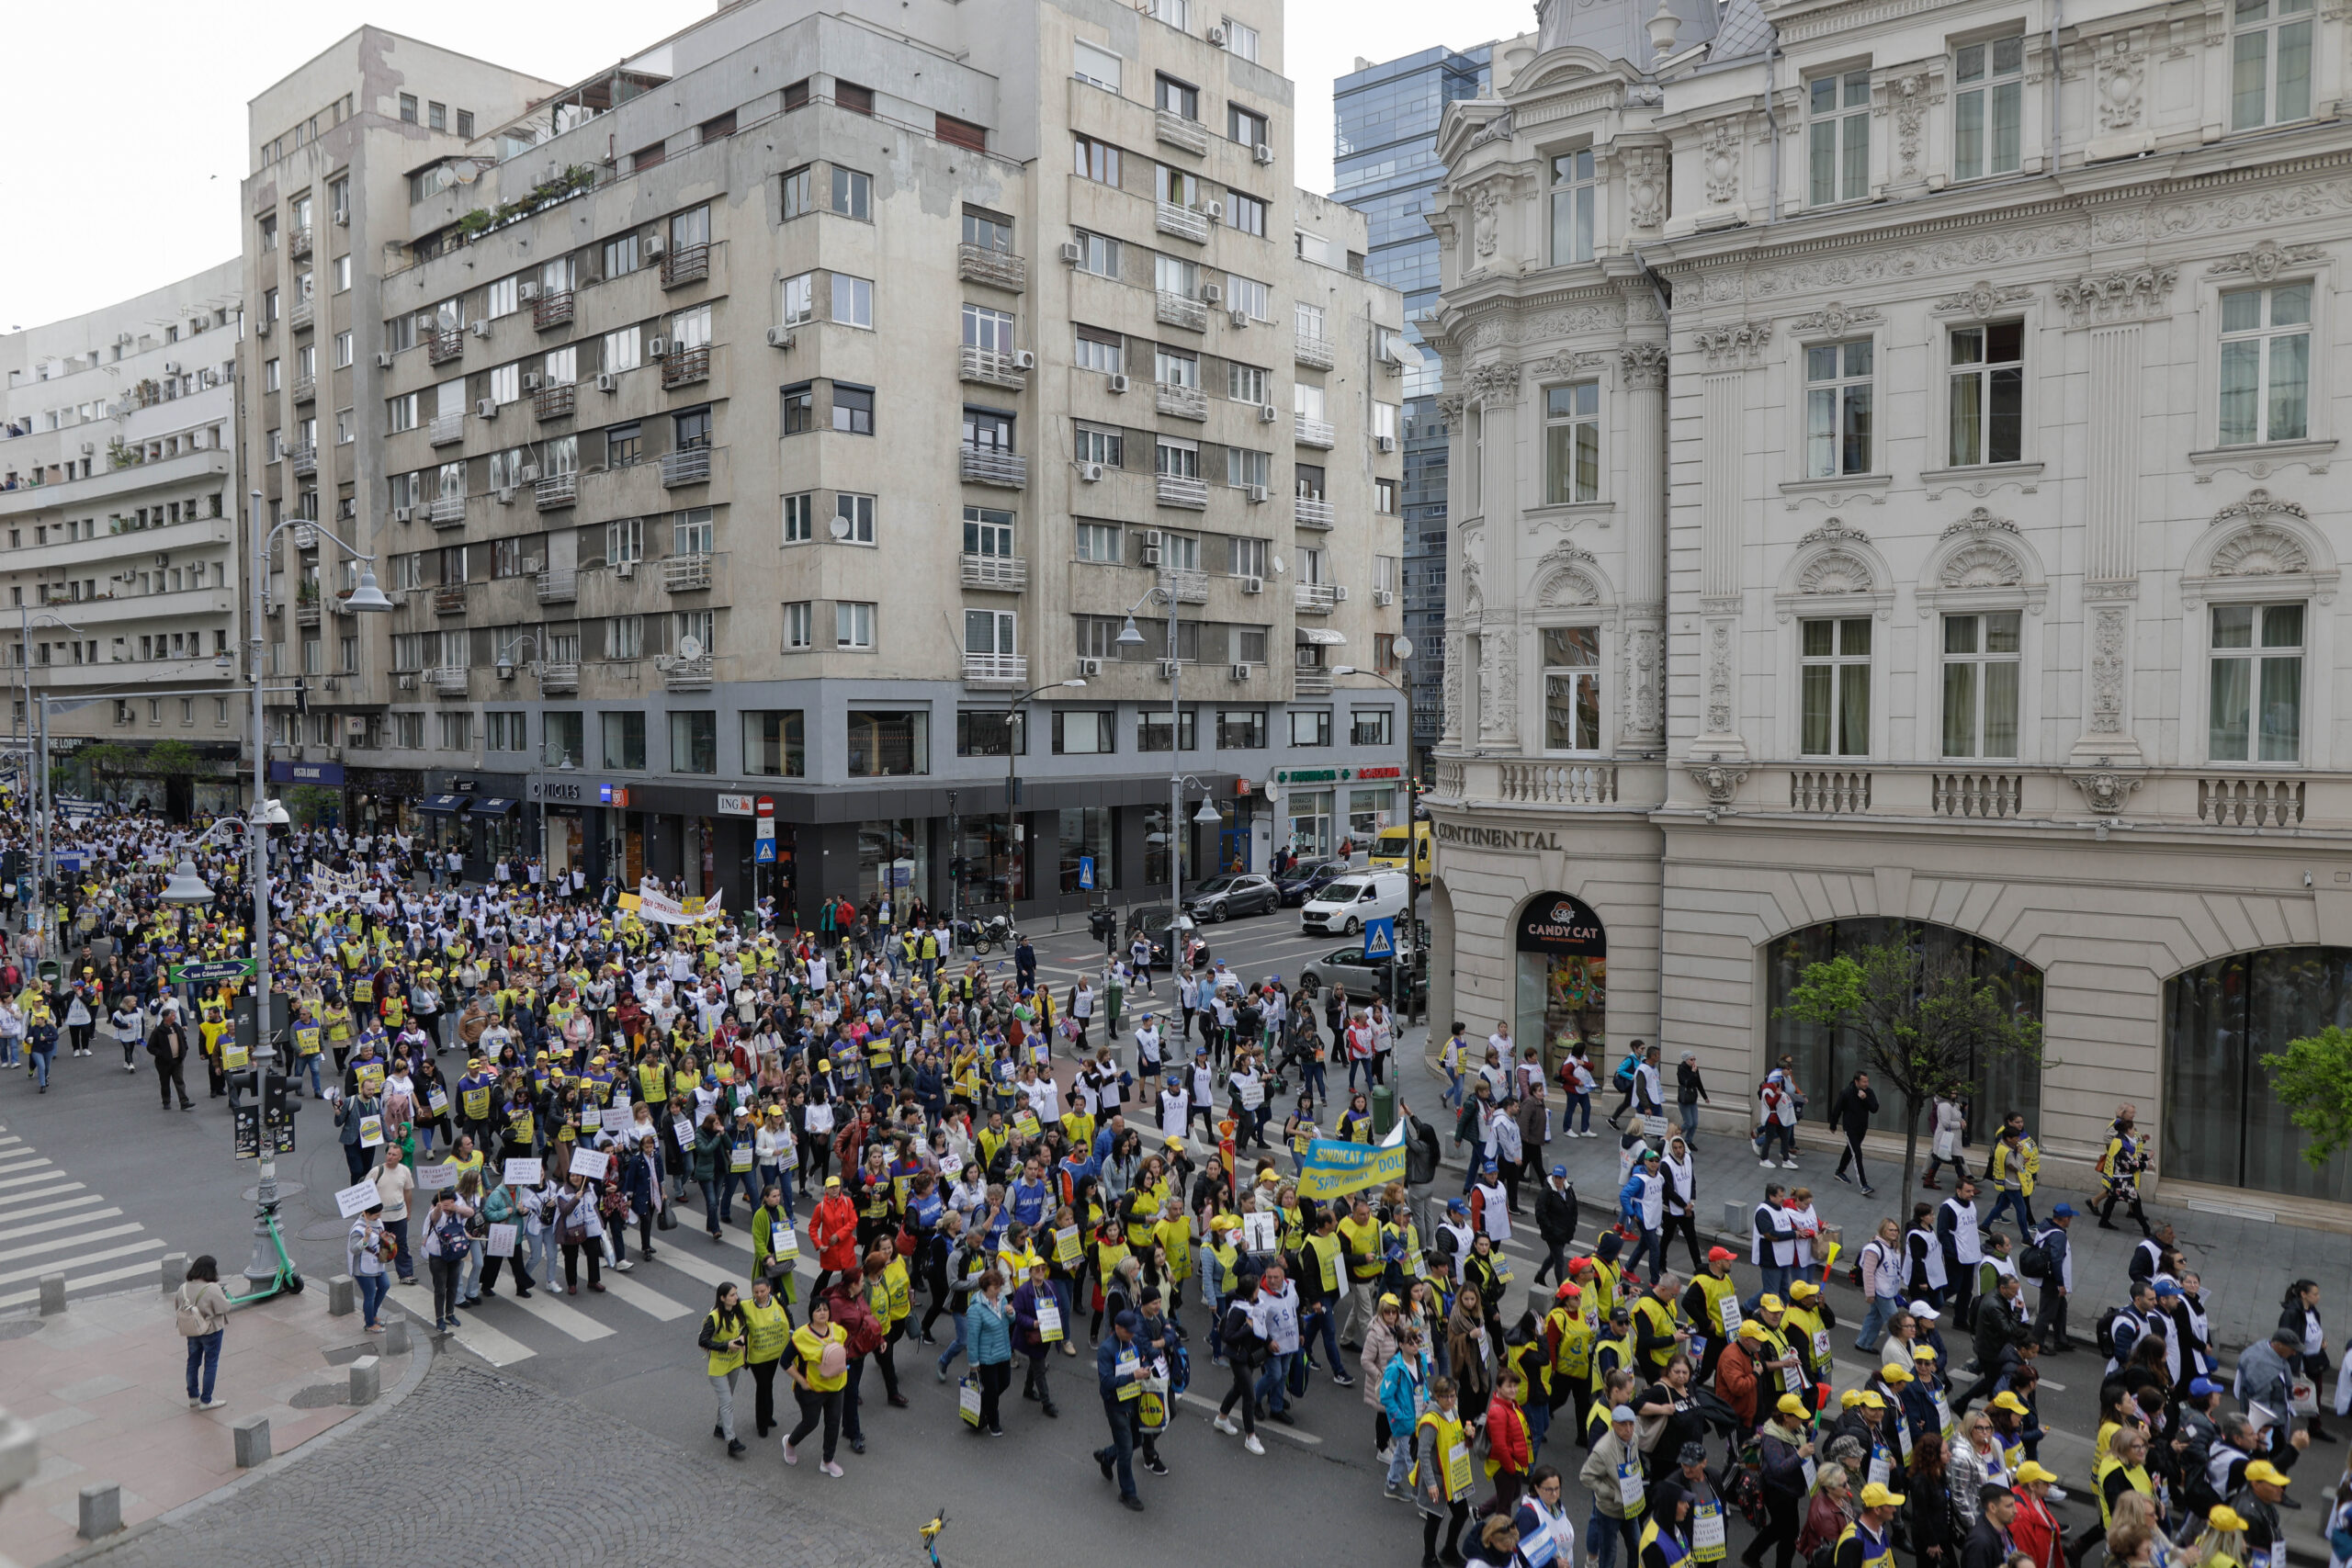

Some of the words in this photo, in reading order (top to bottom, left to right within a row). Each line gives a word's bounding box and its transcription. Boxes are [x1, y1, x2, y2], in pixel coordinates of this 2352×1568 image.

[1291, 770, 1337, 782] FARMACIA
[1358, 767, 1401, 779] ACADEMIA
[721, 798, 739, 809] ING
[1438, 822, 1562, 851] CONTINENTAL
[1528, 923, 1571, 937] CANDY
[1572, 927, 1599, 939] CAT
[1315, 1148, 1362, 1164] SINDICAT
[1702, 1503, 1716, 1514] FSE
